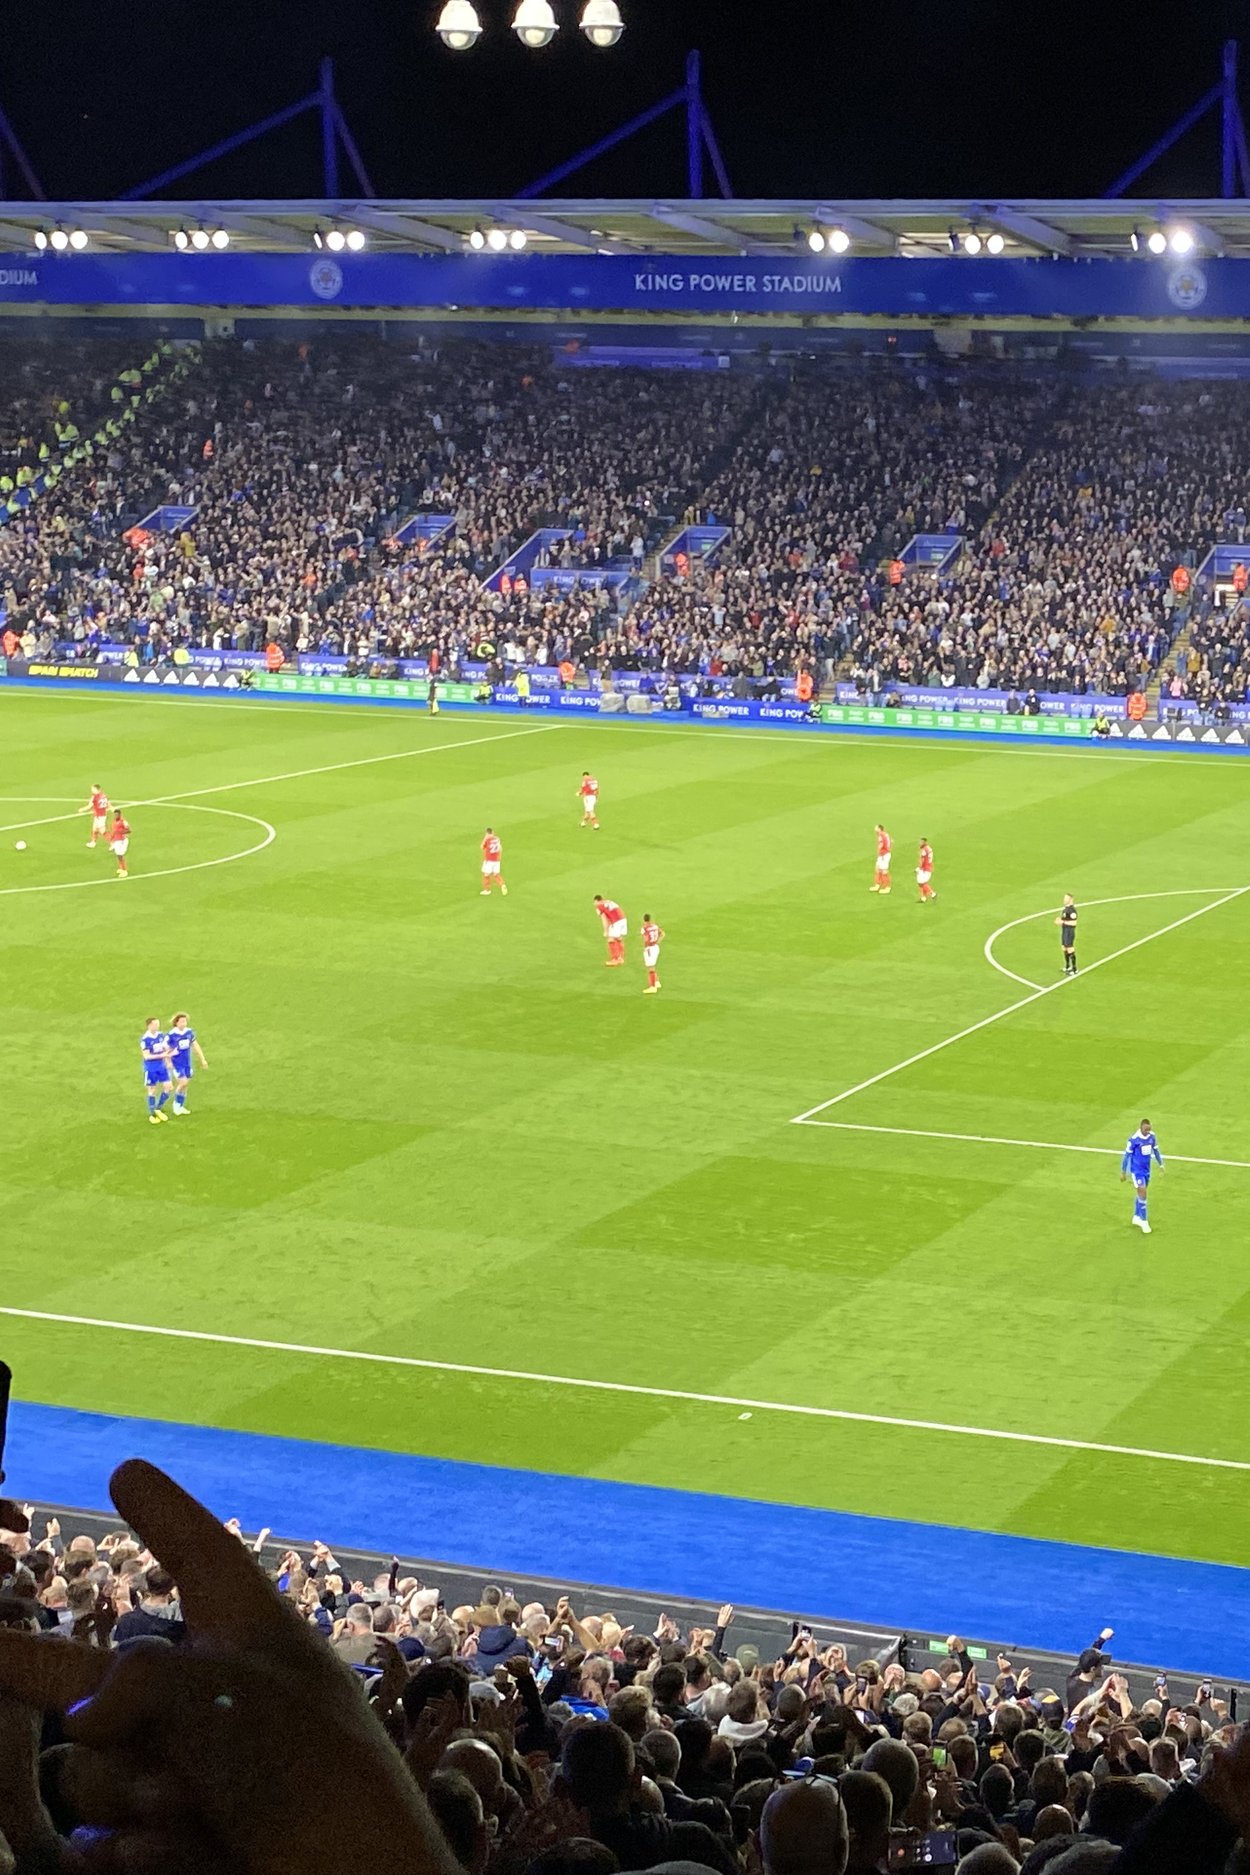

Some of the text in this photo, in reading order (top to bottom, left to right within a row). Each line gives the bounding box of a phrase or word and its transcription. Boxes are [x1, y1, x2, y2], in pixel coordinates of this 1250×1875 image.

[635, 275, 840, 292] KING POWER STADIUM
[496, 692, 518, 701] KING
[561, 696, 583, 706] KING
[977, 698, 1007, 708] POWER
[692, 703, 750, 715] KING POWER
[760, 708, 783, 718] KING
[1094, 704, 1125, 714] POWER
